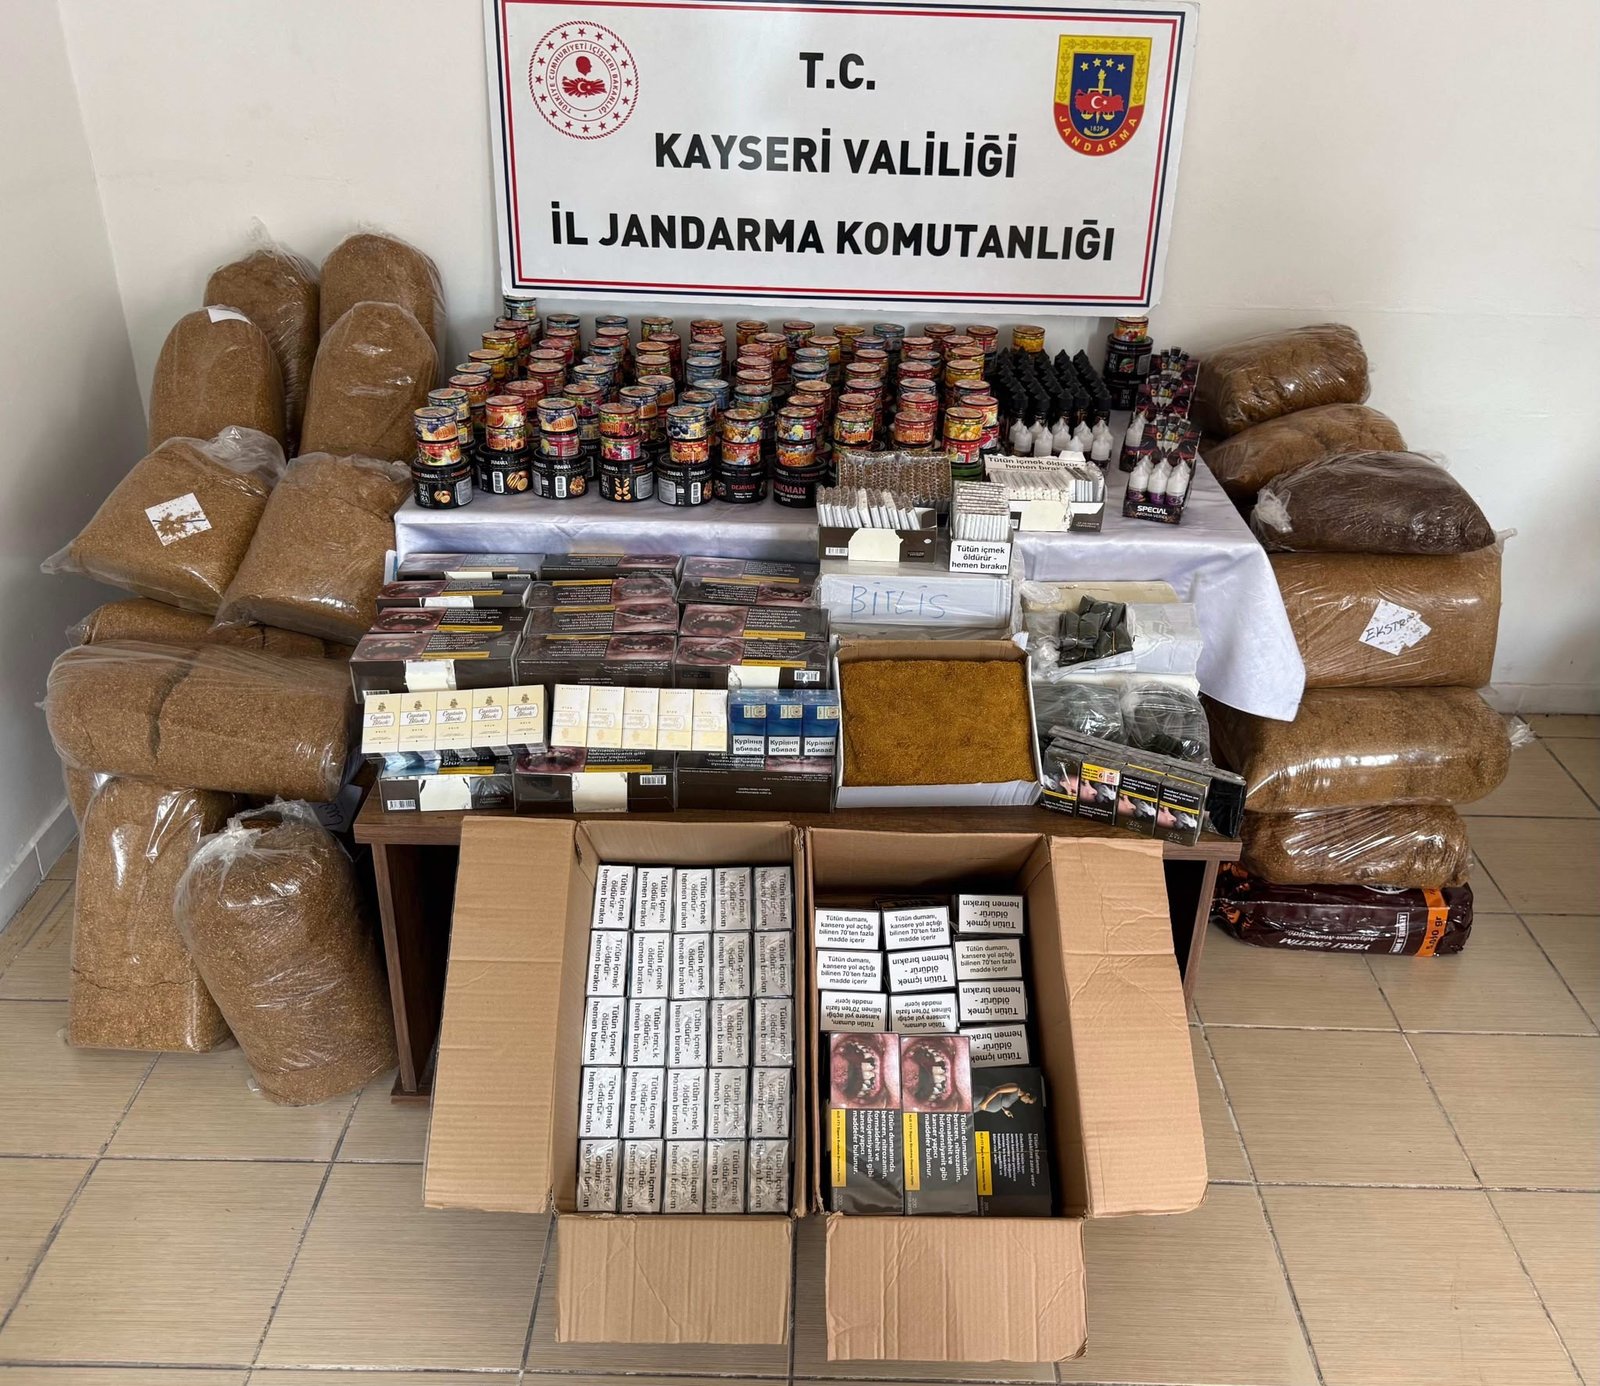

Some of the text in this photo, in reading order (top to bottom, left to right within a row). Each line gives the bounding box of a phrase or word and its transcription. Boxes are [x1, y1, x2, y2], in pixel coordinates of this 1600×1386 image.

[549, 43, 619, 115] TÜRKİYE CUMHURİYETİ İÇİŞLERİ BAKANLIĞI
[799, 52, 876, 90] T.C.
[1059, 115, 1137, 153] JANDARMA
[655, 128, 1017, 178] KAYSERİ VALİLİĞİ
[551, 201, 1115, 261] İL JANDARMA KOMUTANLIĞI
[988, 456, 1078, 467] Tütün içmek öldürür
[1137, 505, 1168, 515] SPECIAL
[981, 546, 1005, 554] içmek
[850, 581, 948, 620] BİTLİS
[735, 738, 763, 746] Куріння
[770, 739, 798, 747] Куріння
[806, 740, 834, 748] Куріння
[598, 869, 610, 924] hemen bırakın
[610, 880, 618, 907] öldürür
[617, 873, 628, 921] Tütün içmek
[650, 882, 658, 910] öldürür
[690, 884, 698, 911] öldürür
[659, 900, 667, 923] içmek
[680, 901, 688, 928] bırakın
[699, 901, 707, 925] içmek
[966, 919, 991, 928] içmek
[925, 920, 942, 928] açtığı
[1279, 937, 1331, 950] ÜRETİM
[637, 937, 646, 994] hemen bırakın
[678, 937, 686, 995] hemen bırakın
[697, 941, 705, 990] Tütün içmek
[892, 954, 949, 965] hemen bırakın
[909, 965, 939, 974] öldürür
[656, 965, 664, 990] içmek
[897, 975, 948, 986] Tütün içmek
[980, 997, 1010, 1005] öldürür
[993, 986, 1020, 994] hemen
[967, 1006, 1018, 1015] Tütün içmek
[589, 1001, 600, 1061] hemen bırakın
[600, 1012, 609, 1042] öldürür
[609, 1005, 619, 1057] Tütün içmek
[971, 1030, 1022, 1041] hemen bırak
[971, 1052, 1021, 1063] Tütün içmek
[982, 1042, 1012, 1051] öldürür
[888, 1132, 896, 1173] dumanında
